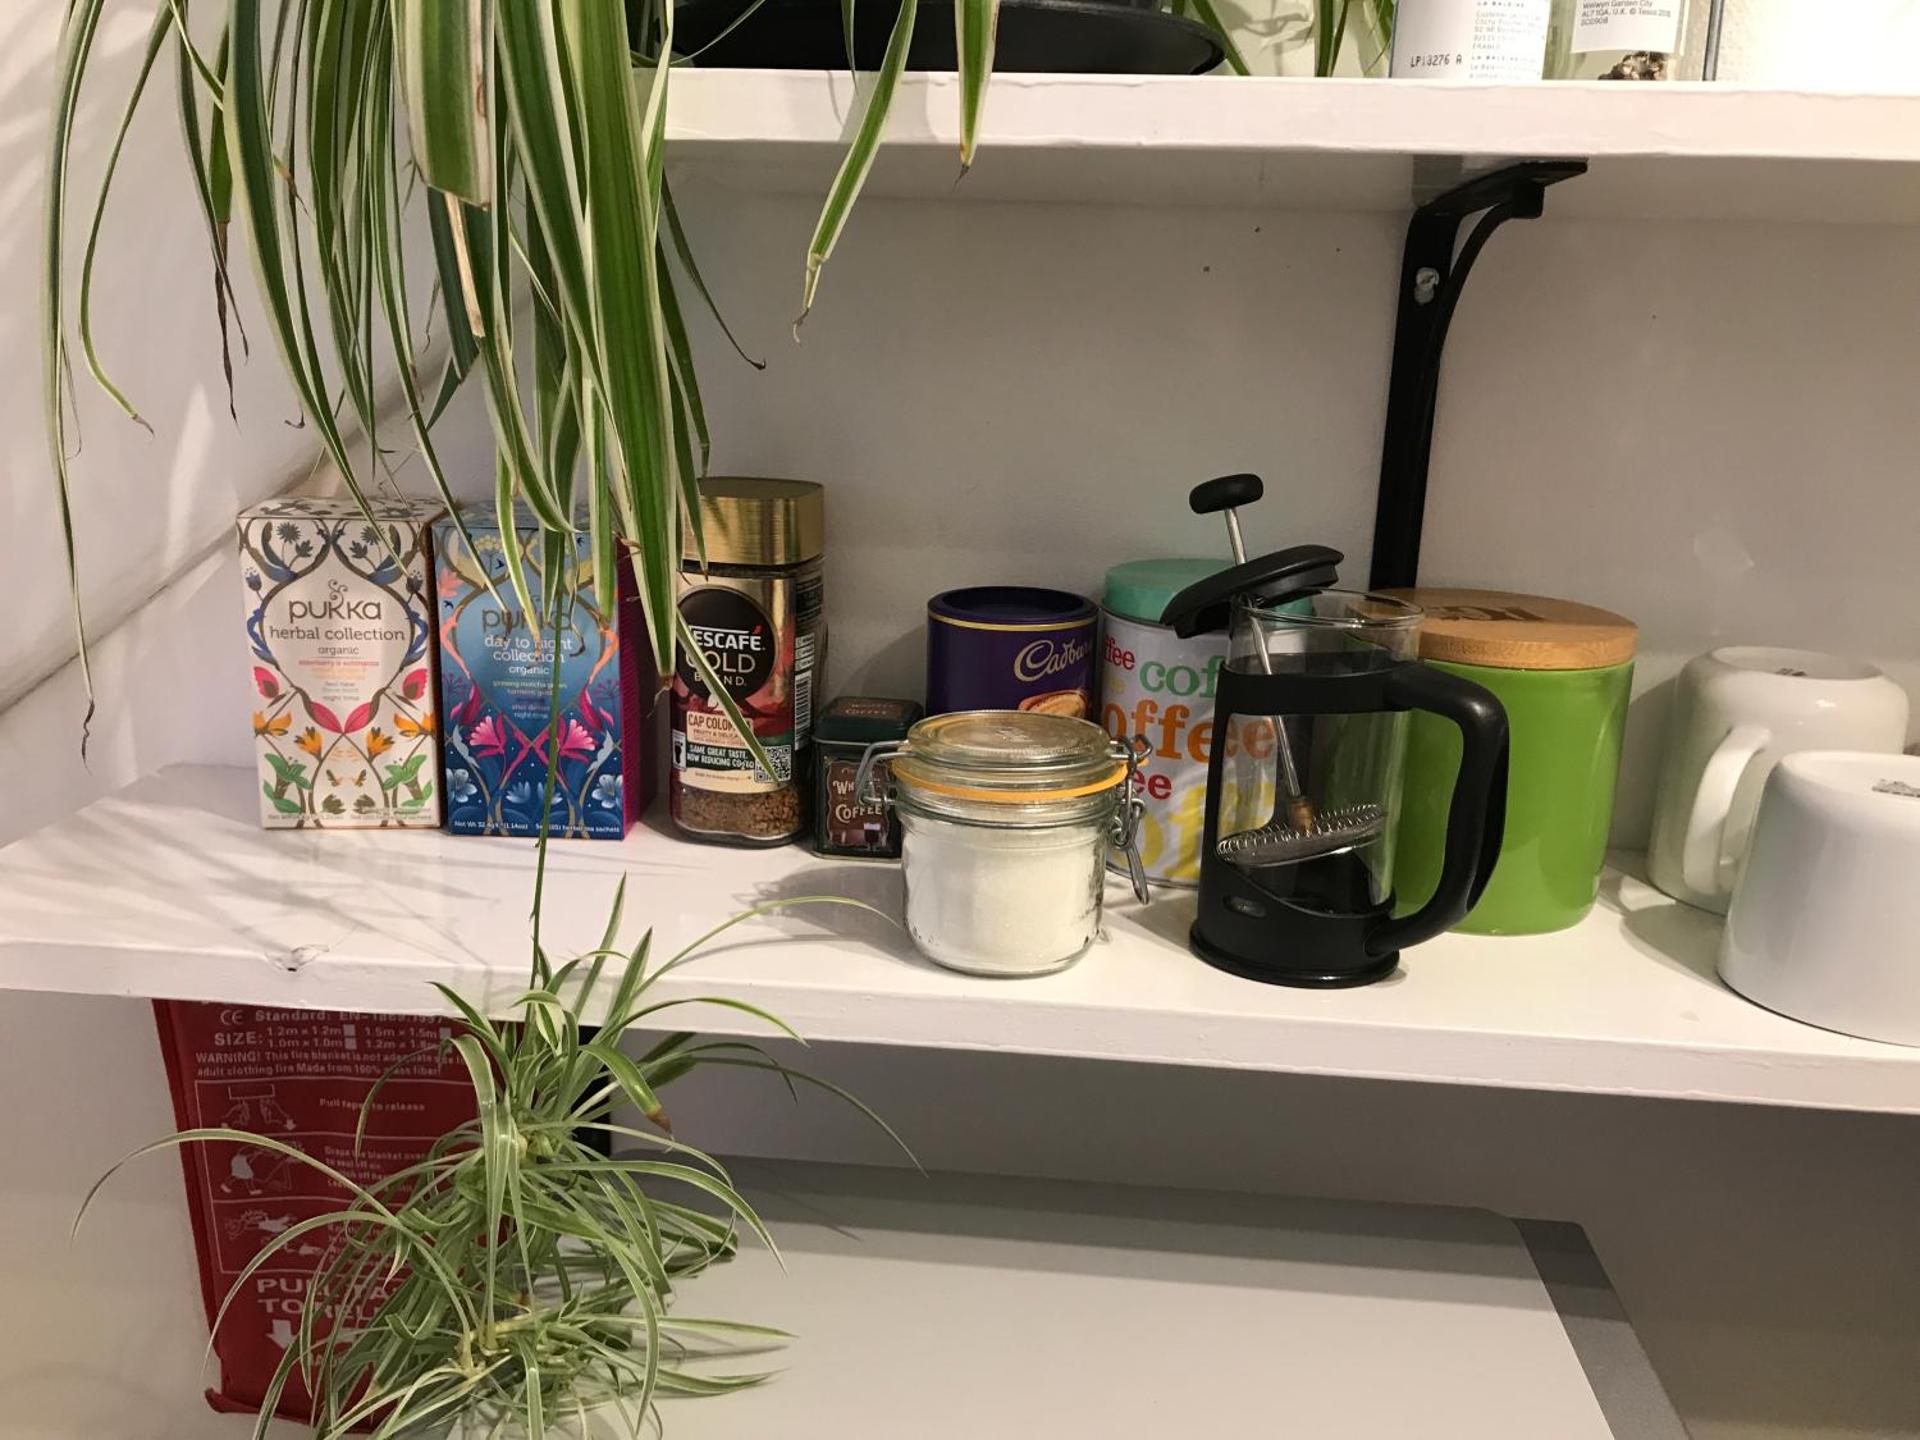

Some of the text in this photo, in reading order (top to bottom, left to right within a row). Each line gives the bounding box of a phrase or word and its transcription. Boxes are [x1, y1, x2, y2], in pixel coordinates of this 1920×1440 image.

[1456, 54, 1462, 64] A
[289, 591, 382, 624] pukka
[482, 608, 573, 634] pua
[269, 625, 405, 642] herbal collection
[689, 626, 762, 651] ESCAFÉ
[484, 634, 512, 650] day
[515, 637, 530, 649] to
[317, 646, 360, 657] organic
[492, 649, 566, 663] collecion
[508, 666, 550, 676] organic
[1139, 654, 1227, 699] cof
[694, 671, 745, 686] BND
[688, 713, 705, 727] CAP
[1102, 698, 1276, 765] offee
[689, 744, 705, 754] SAME
[707, 746, 726, 756] GREAT
[701, 755, 731, 767] REDUCING
[836, 804, 882, 825] COFFEE
[255, 1009, 332, 1022] Standard:
[214, 1030, 263, 1047] SIZE:
[267, 1025, 299, 1037] 1.2m
[312, 1025, 342, 1036] 1.2m
[364, 1027, 396, 1038] 1.5m
[409, 1027, 438, 1040] 1.5m
[268, 1038, 300, 1049] 1.0m
[314, 1038, 343, 1048] 1.0m
[195, 1051, 261, 1064] WARNING!
[265, 1051, 289, 1061] This
[290, 1051, 309, 1060] fire
[311, 1051, 351, 1062] blanket
[362, 1053, 381, 1062] not
[383, 1053, 433, 1064] adeate
[197, 1066, 224, 1077] adult
[226, 1064, 274, 1076] clothing
[296, 1062, 326, 1073] Made
[326, 1063, 352, 1073] from
[354, 1063, 381, 1075] 100%
[341, 1100, 369, 1111] tape
[371, 1102, 384, 1111] to
[385, 1102, 426, 1111] release
[367, 1151, 403, 1160] blanket
